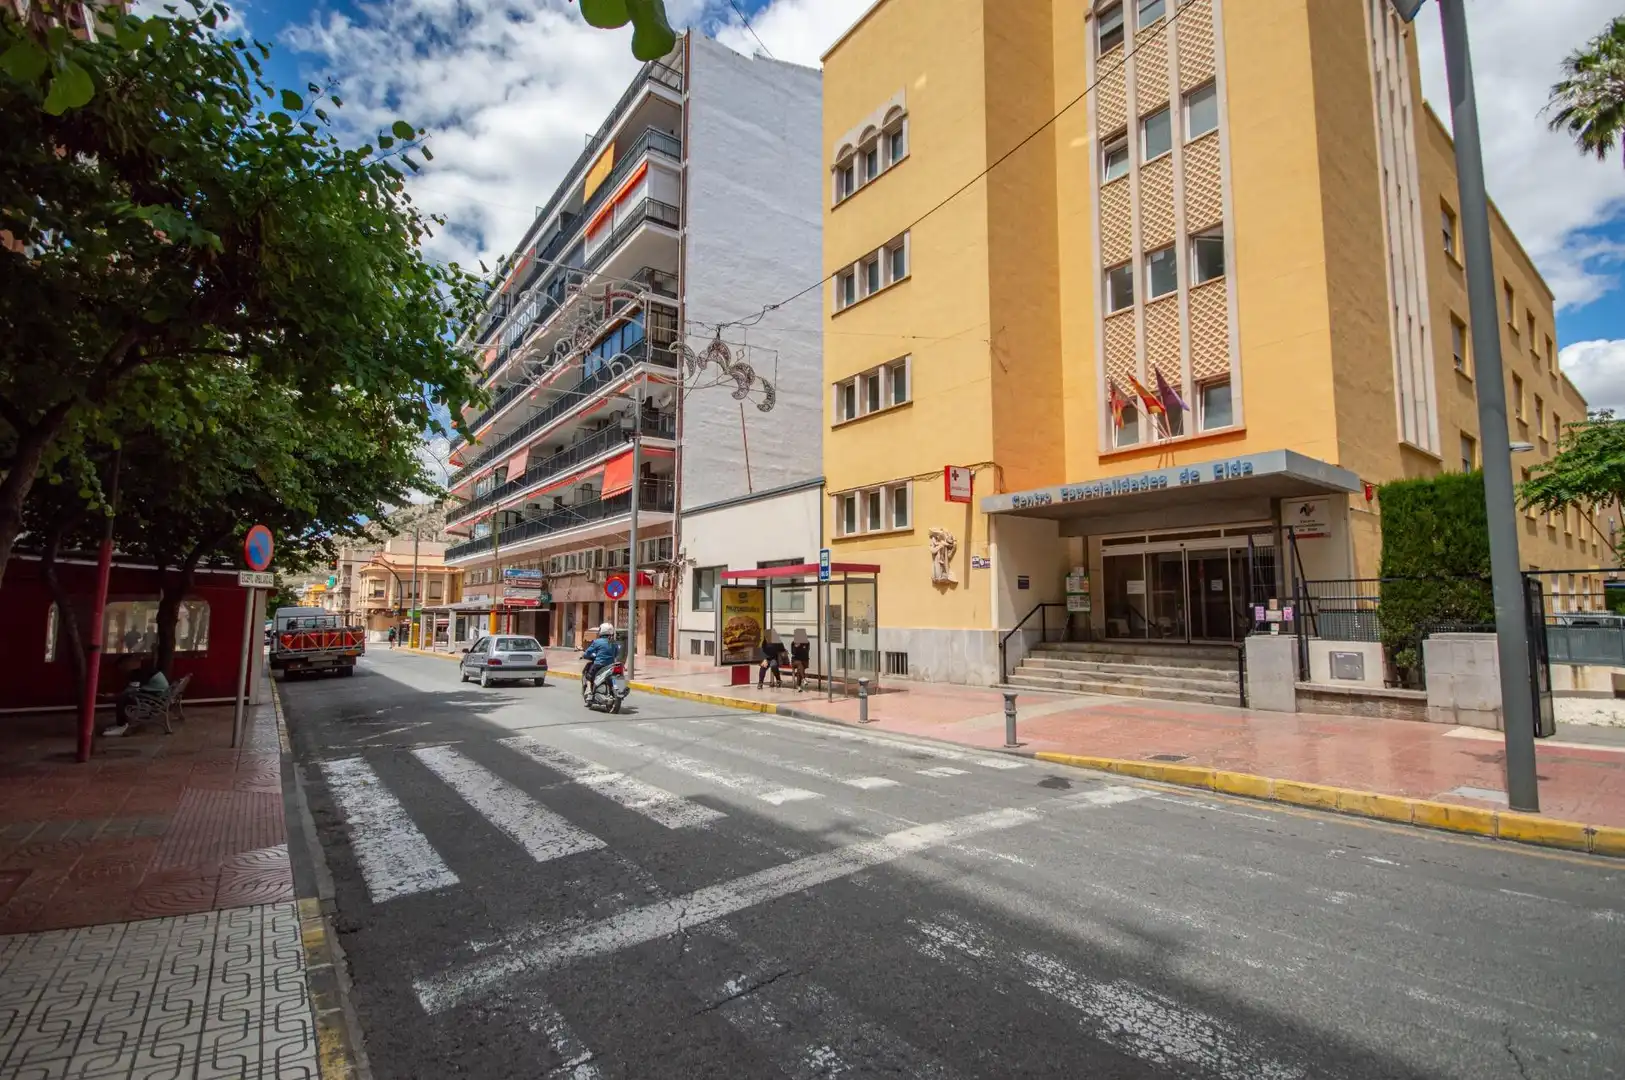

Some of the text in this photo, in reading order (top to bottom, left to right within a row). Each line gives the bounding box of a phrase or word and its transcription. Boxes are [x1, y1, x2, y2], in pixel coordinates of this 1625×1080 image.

[1012, 460, 1253, 508] Centro Especialidades de Elda
